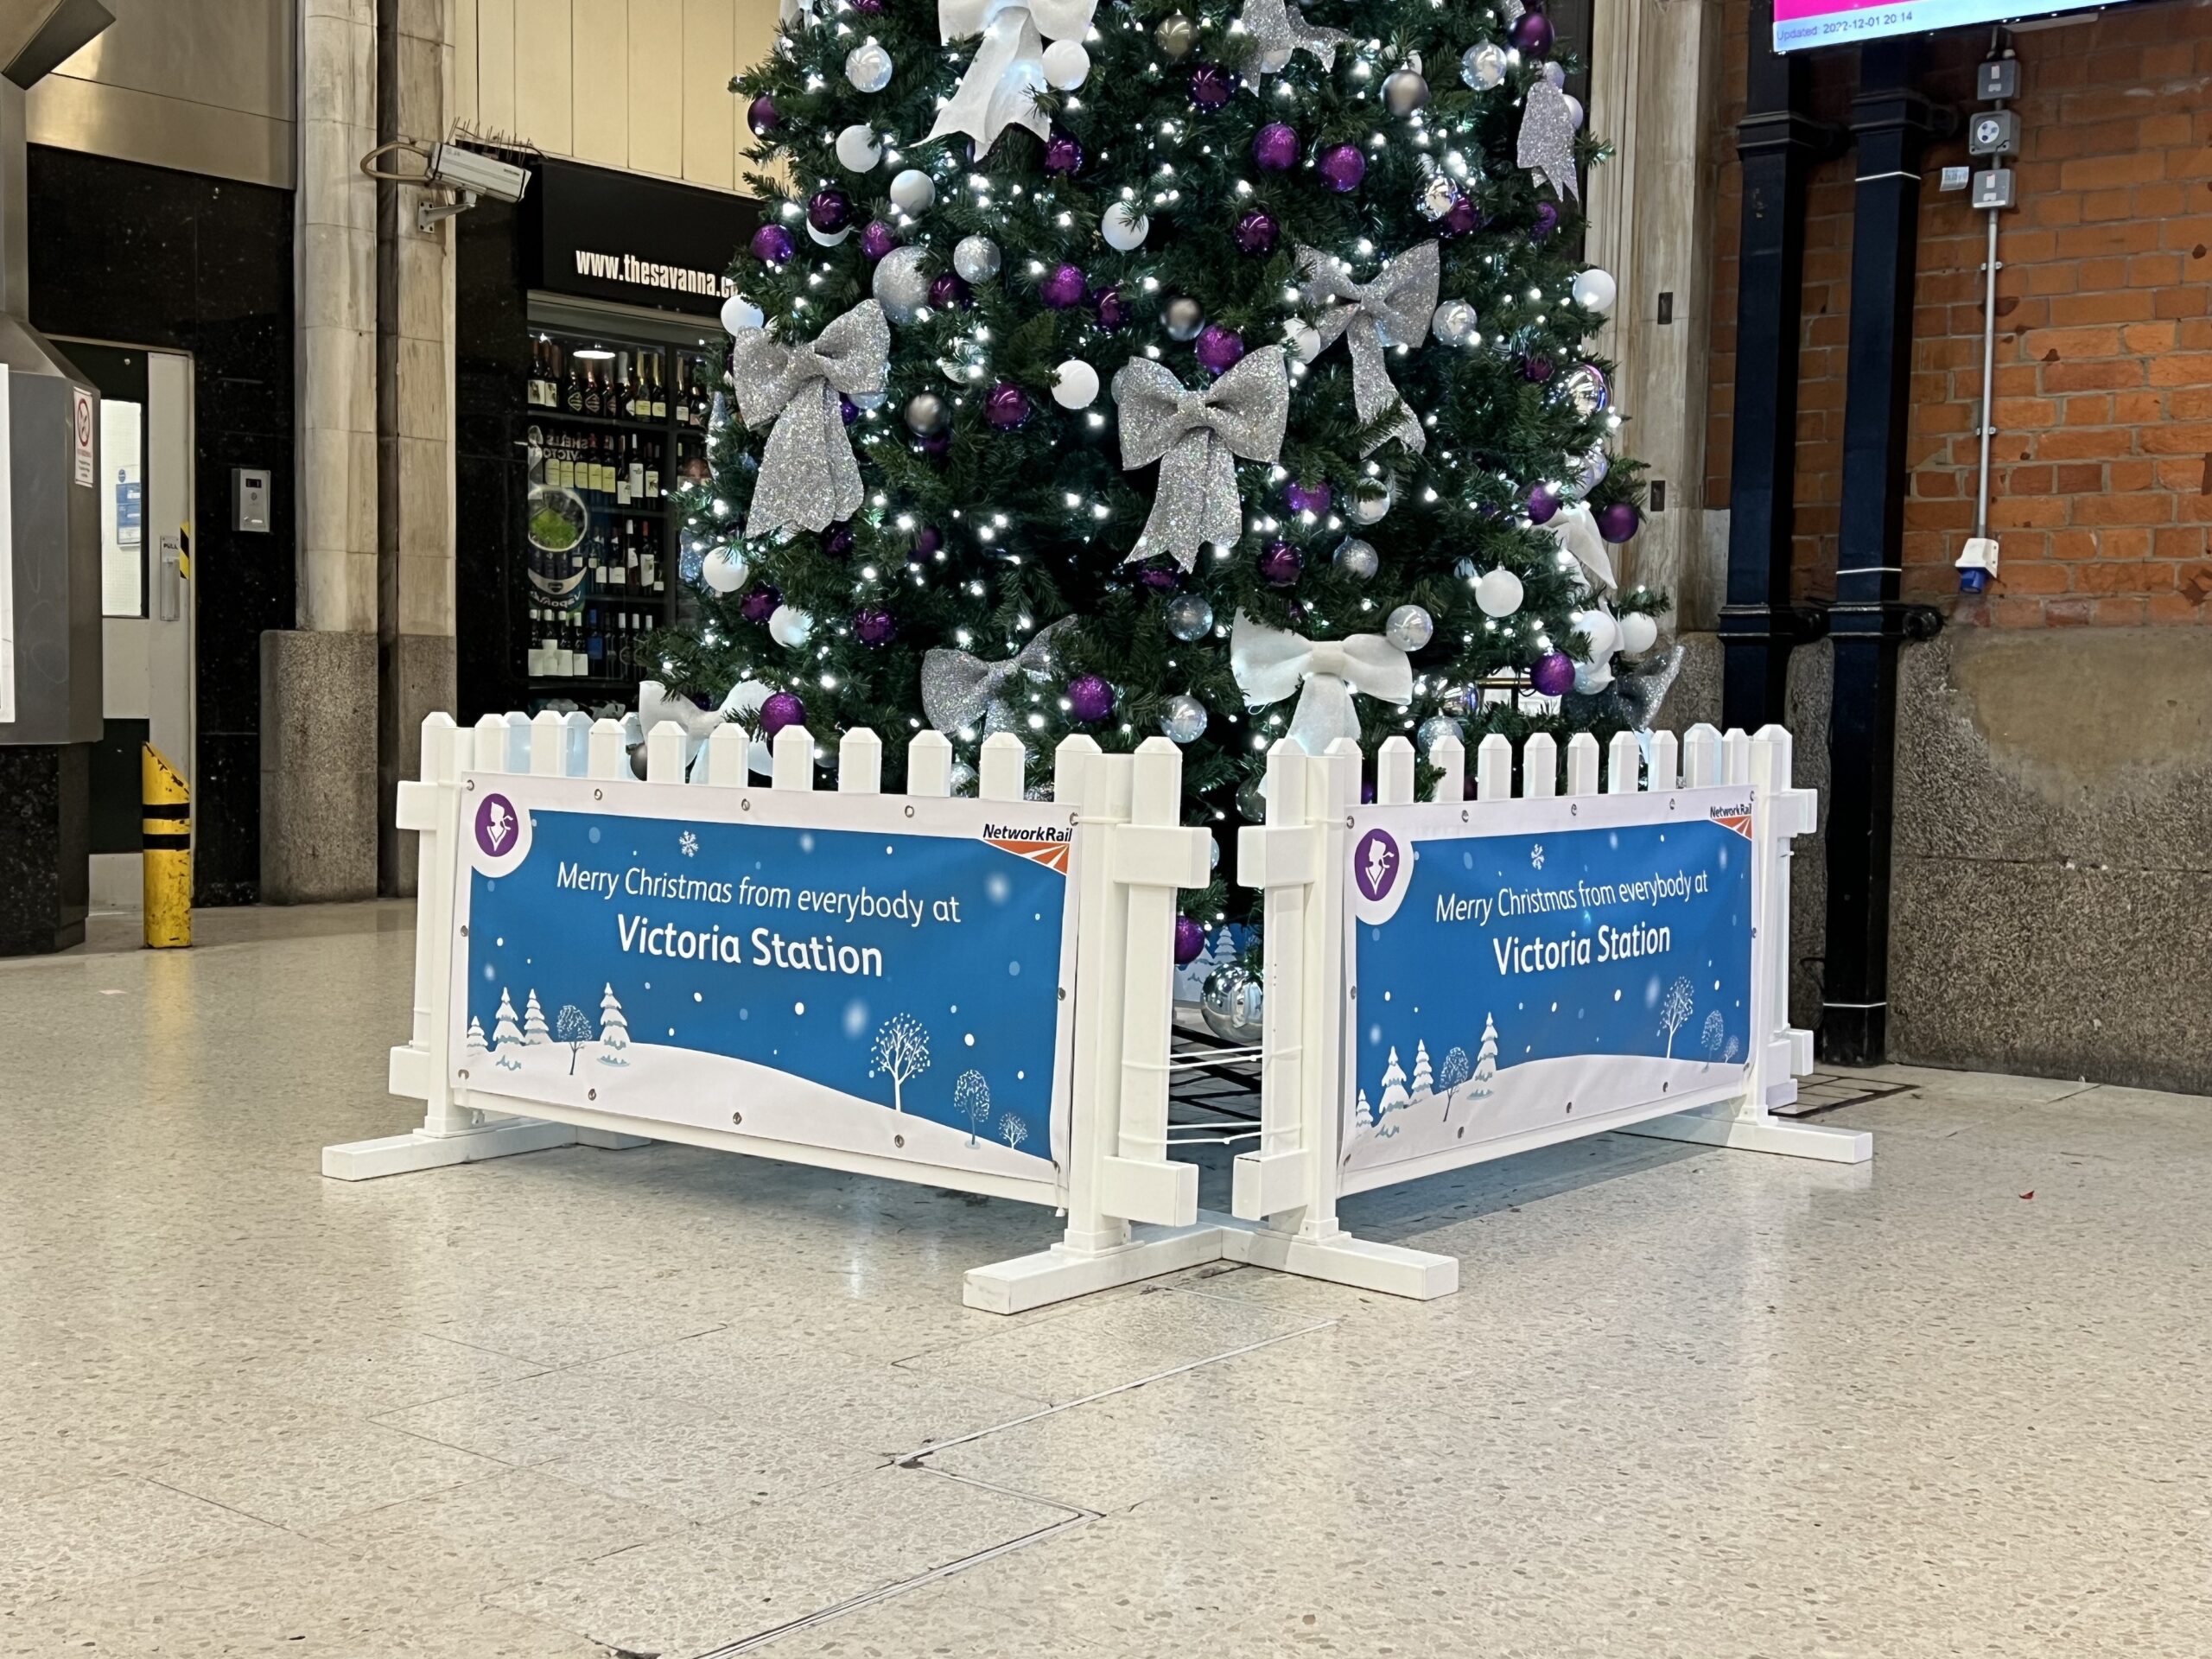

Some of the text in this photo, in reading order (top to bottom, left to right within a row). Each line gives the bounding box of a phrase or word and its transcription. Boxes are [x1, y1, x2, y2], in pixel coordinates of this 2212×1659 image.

[1823, 15, 1880, 35] 2022-12-01
[1884, 10, 1912, 26] 2014
[983, 823, 1072, 842] NetworkRail
[556, 861, 961, 928] Merry Christmas from everybody at
[1435, 869, 1708, 927] Merry Christmas from everybody at
[617, 913, 883, 977] Victoria Station
[1493, 921, 1671, 976] Victoria Station
